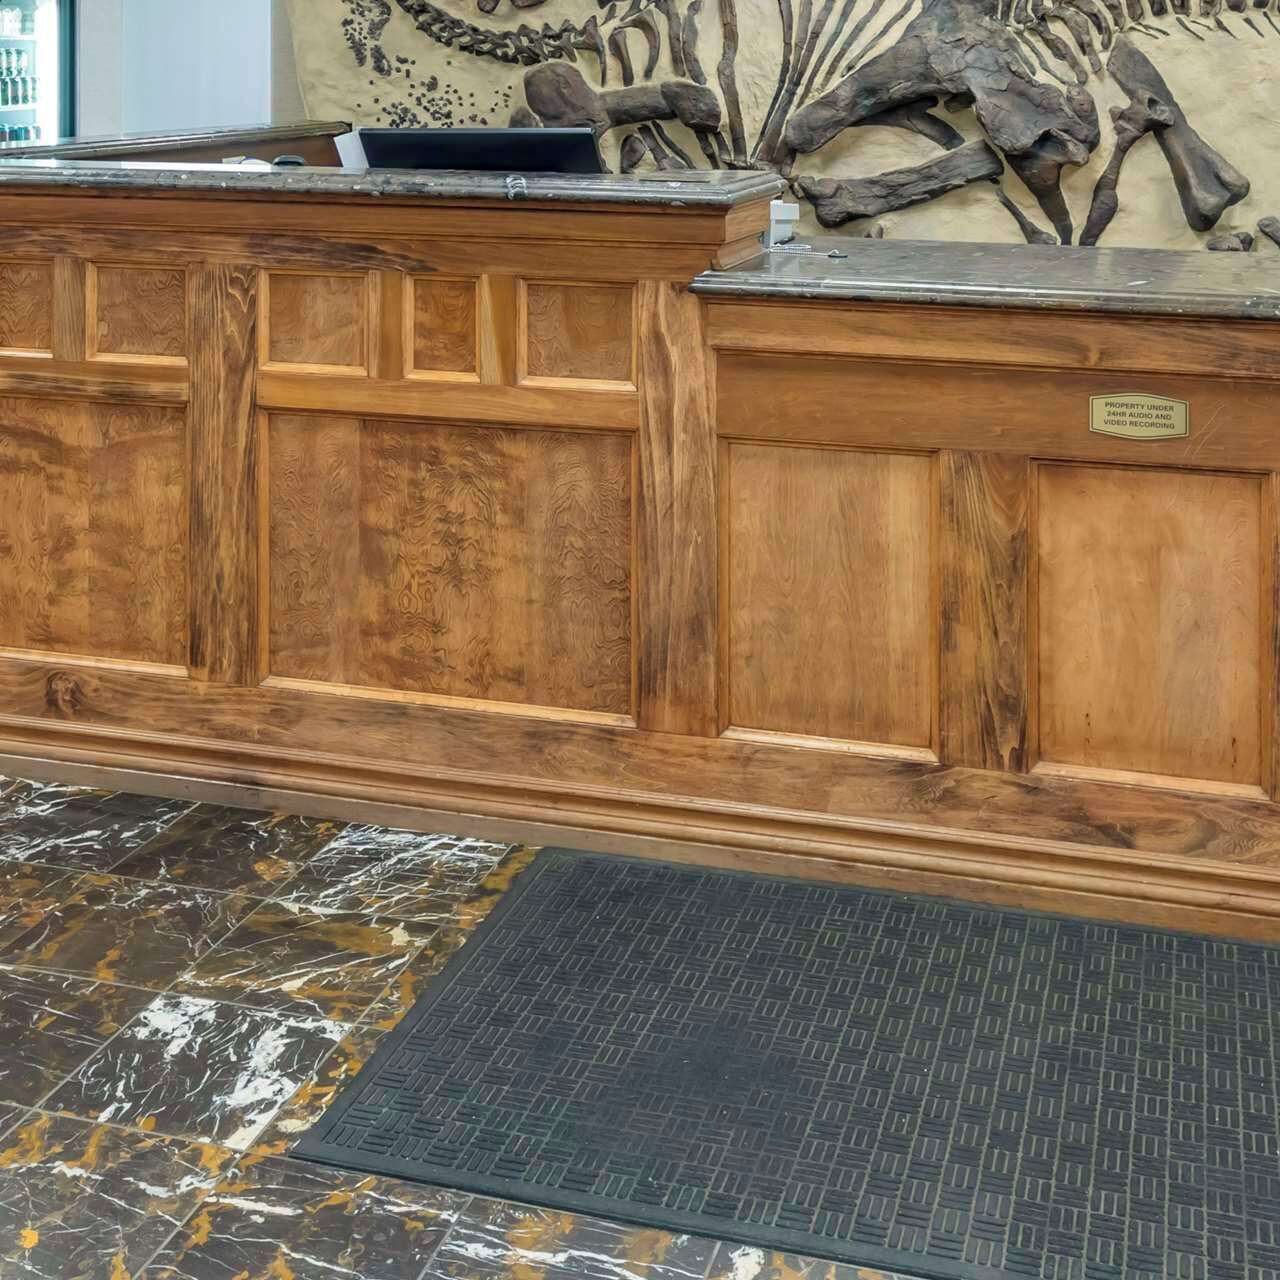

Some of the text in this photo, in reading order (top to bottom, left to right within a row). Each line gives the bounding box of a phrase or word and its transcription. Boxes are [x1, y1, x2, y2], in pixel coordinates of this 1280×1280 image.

[1104, 401, 1174, 412] PROPERTY UNDER
[1128, 411, 1153, 419] AUDIO
[1103, 418, 1175, 429] VIDEO RECORDING
